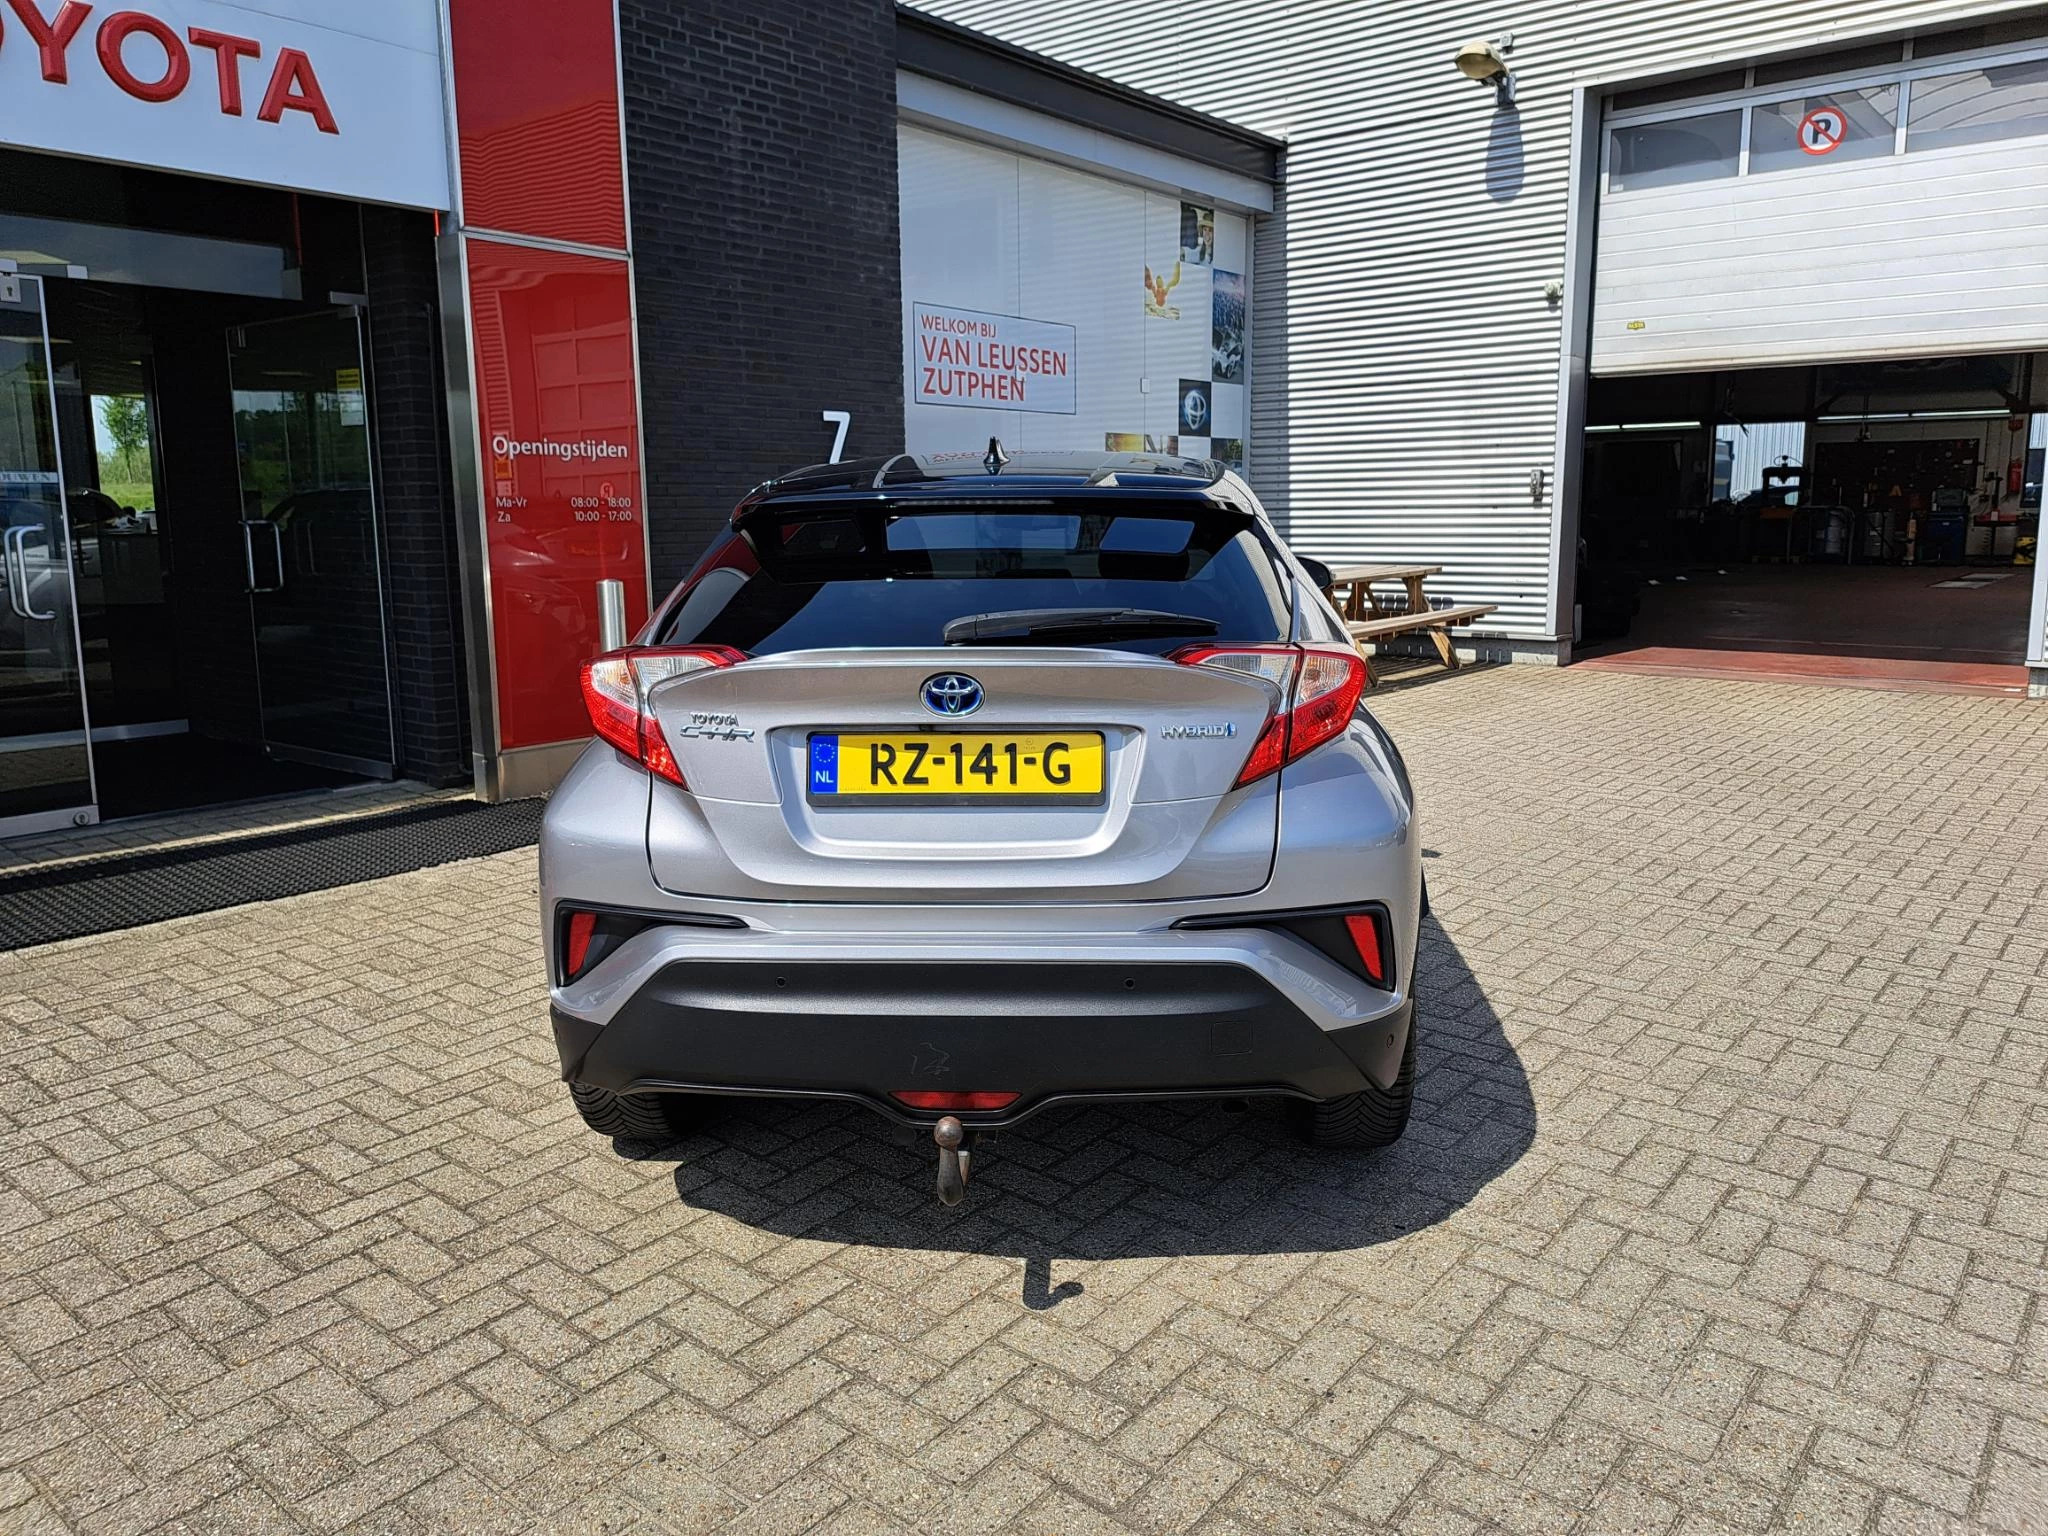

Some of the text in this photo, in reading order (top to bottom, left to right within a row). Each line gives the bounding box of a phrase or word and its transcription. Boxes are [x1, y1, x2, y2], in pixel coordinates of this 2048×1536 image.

[0, 0, 340, 135] YOTA
[1811, 118, 1832, 145] P
[921, 314, 997, 338] WELKOM BIJ
[921, 335, 1066, 376] VAN LEUSSEN
[923, 367, 1025, 401] ZUTPHEN
[493, 436, 628, 461] Openingstijden
[823, 410, 851, 465] 7
[496, 496, 527, 508] Ma-Vr
[571, 498, 599, 508] 08:00
[607, 498, 631, 508] 18:00
[498, 511, 511, 522] Za
[575, 511, 600, 521] 10:00
[608, 511, 632, 521] 17:00
[690, 712, 739, 726] TOYOTA
[1161, 725, 1225, 739] HYBRID
[870, 742, 1071, 785] RZ-141-G
[815, 770, 834, 783] NL
